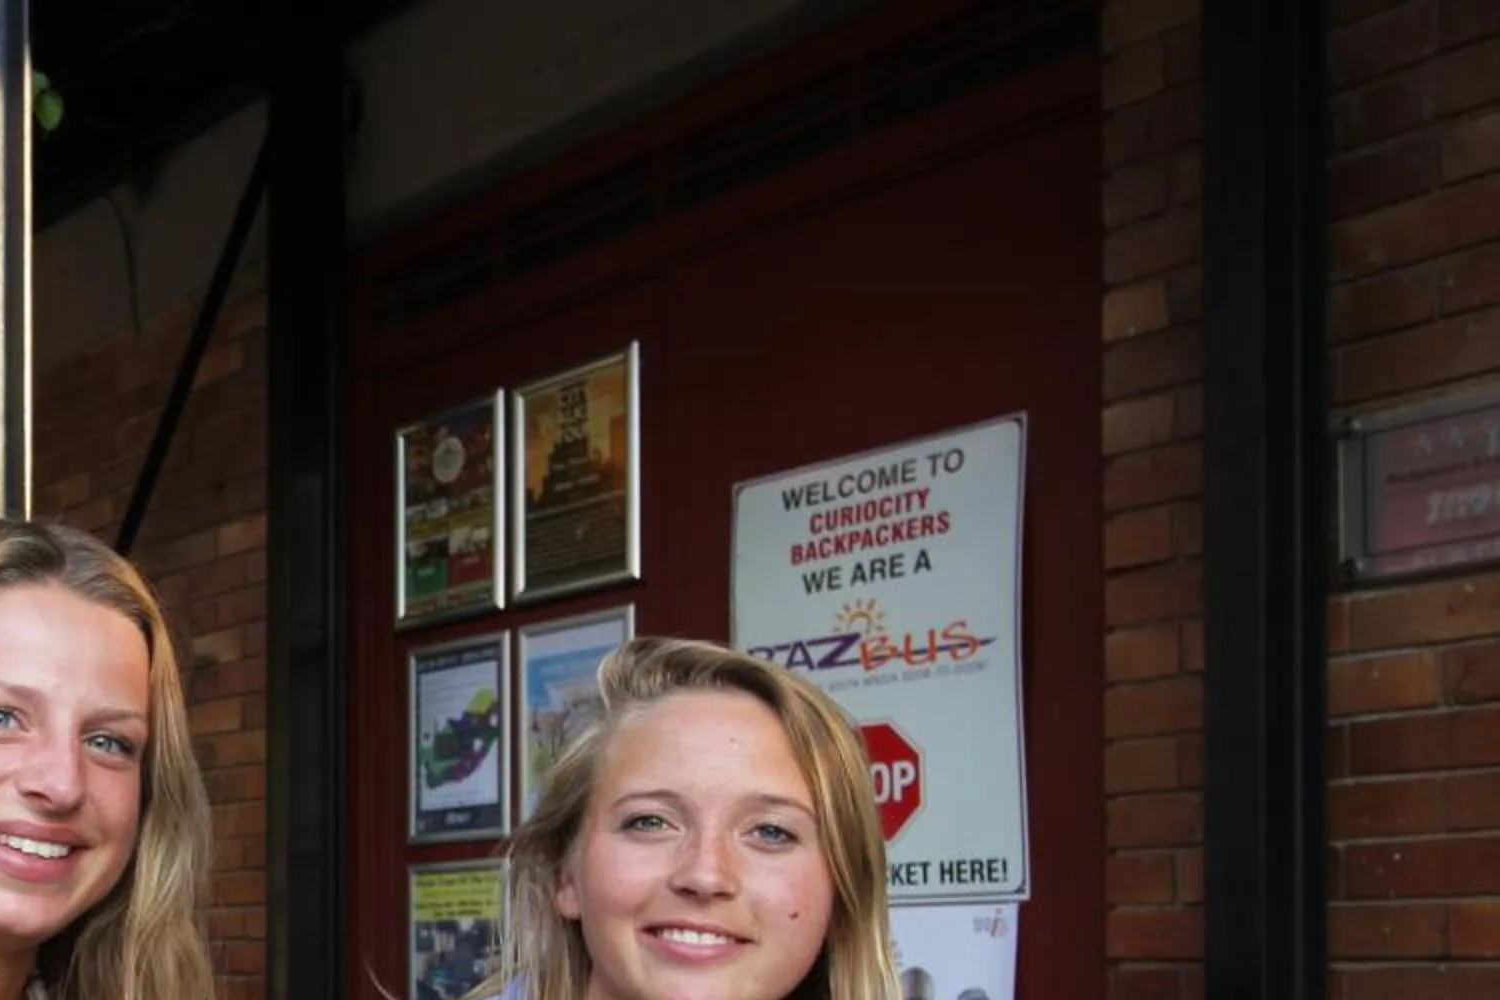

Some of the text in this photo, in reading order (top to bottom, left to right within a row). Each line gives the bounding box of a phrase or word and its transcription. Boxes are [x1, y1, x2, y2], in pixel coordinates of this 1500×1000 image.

[781, 448, 965, 512] WELCOME TO
[809, 487, 931, 535] CURIOCITY
[789, 511, 951, 566] BACKPACKERS
[802, 550, 932, 595] WE ARE A
[871, 761, 916, 803] OP
[886, 857, 1008, 886] KET HERE!
